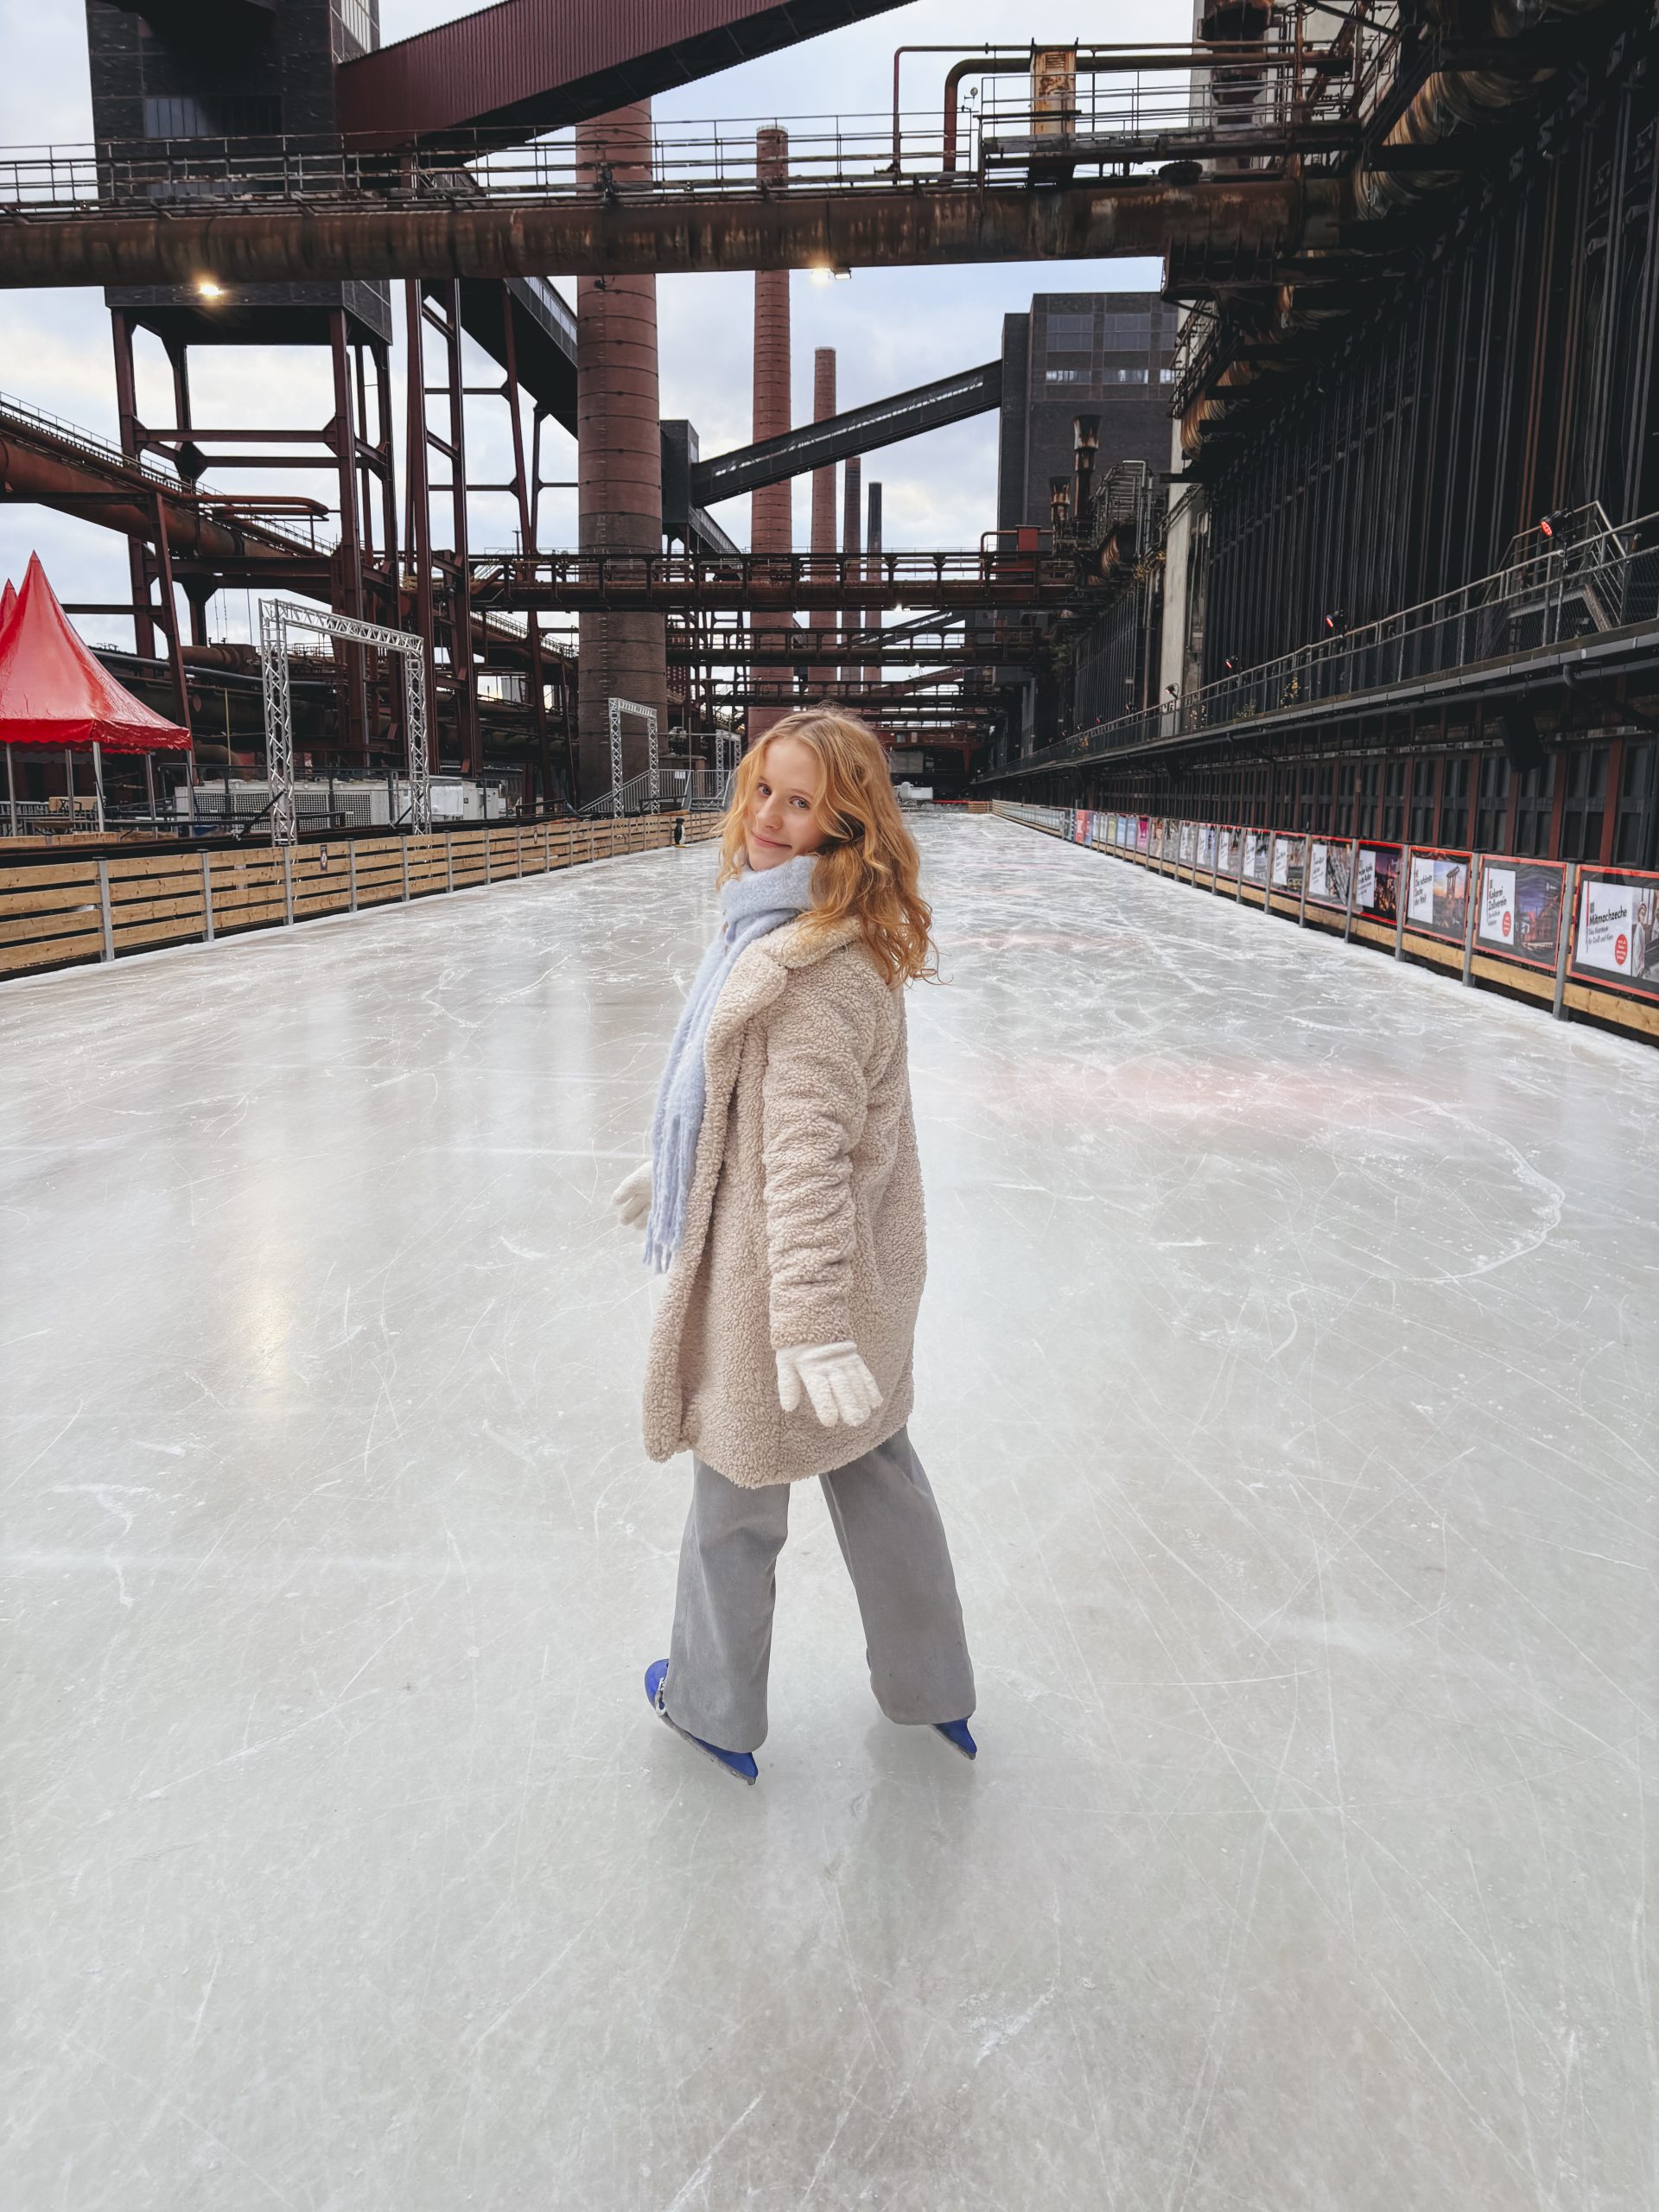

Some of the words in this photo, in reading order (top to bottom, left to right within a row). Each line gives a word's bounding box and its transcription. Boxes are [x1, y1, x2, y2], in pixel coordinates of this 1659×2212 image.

[1489, 885, 1503, 899] Kokerei
[1488, 896, 1507, 910] Zollverein
[1589, 906, 1627, 925] Mitmachzeche
